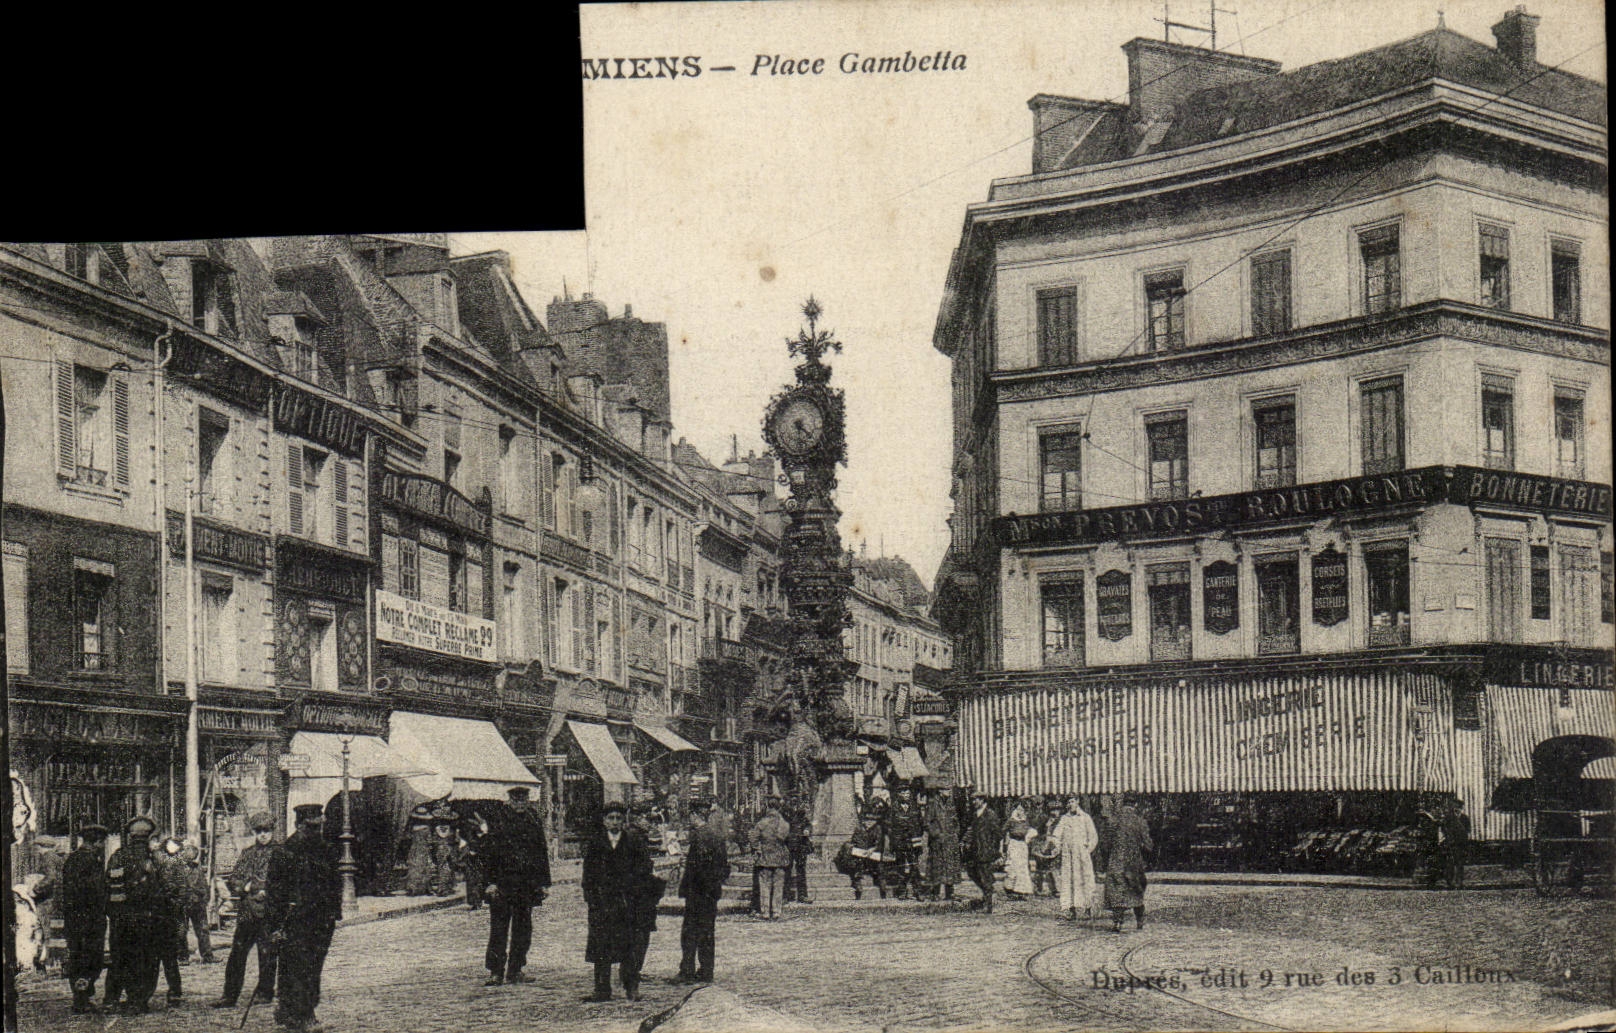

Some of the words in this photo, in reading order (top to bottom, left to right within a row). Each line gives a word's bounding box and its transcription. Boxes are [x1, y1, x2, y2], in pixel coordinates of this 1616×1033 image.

[1470, 472, 1608, 513] BONNETERIE
[1314, 565, 1346, 578] CORSETS
[381, 602, 404, 628] NOTRE
[408, 612, 441, 637] COMPLET
[464, 643, 483, 659] PRIME
[1521, 662, 1614, 687] LINGERIE
[993, 690, 1126, 740] BONNETERIE
[1225, 685, 1324, 725] LINGERIE
